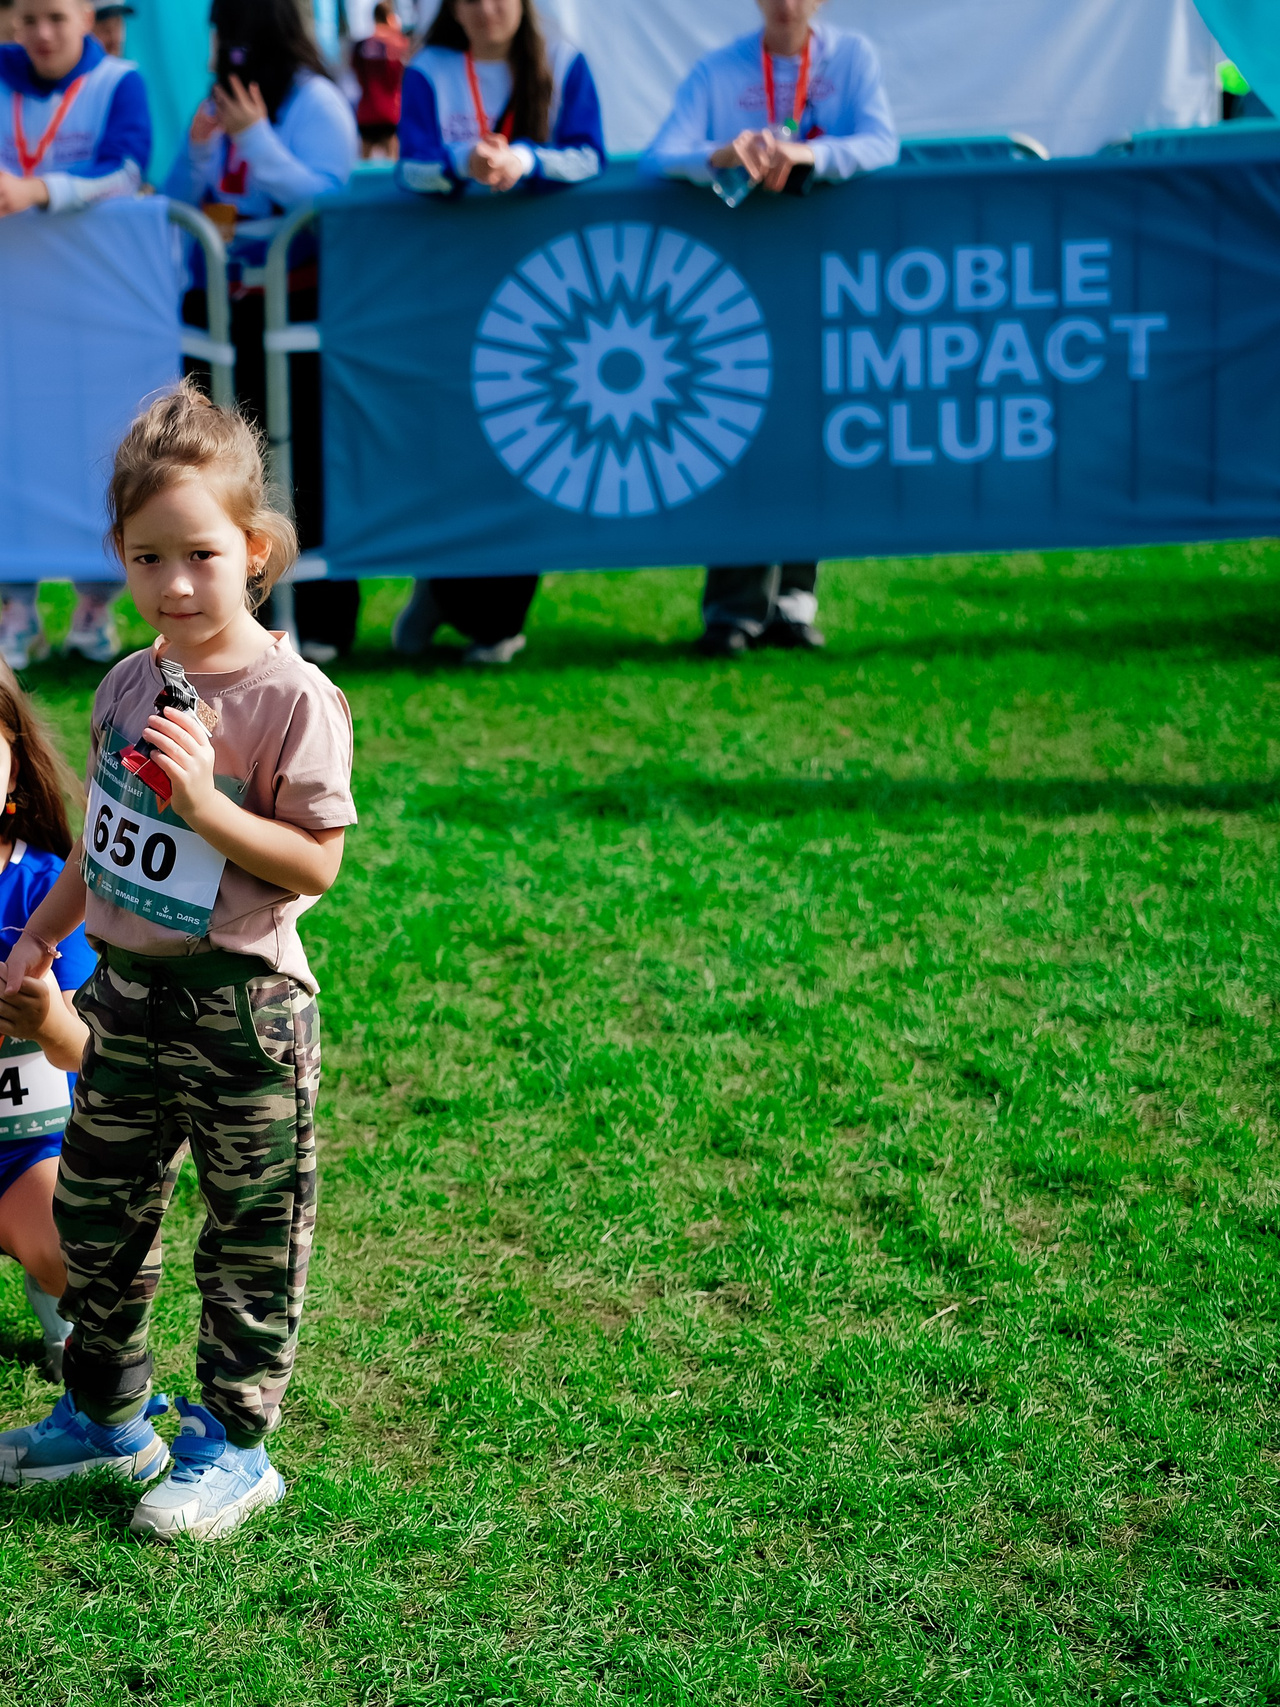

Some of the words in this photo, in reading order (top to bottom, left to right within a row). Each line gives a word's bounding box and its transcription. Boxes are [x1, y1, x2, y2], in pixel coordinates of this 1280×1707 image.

[821, 238, 1111, 319] NOBLE
[822, 311, 1169, 394] IMPACT
[823, 393, 1057, 470] CLUB
[93, 804, 177, 882] 650
[176, 912, 200, 925] DARS
